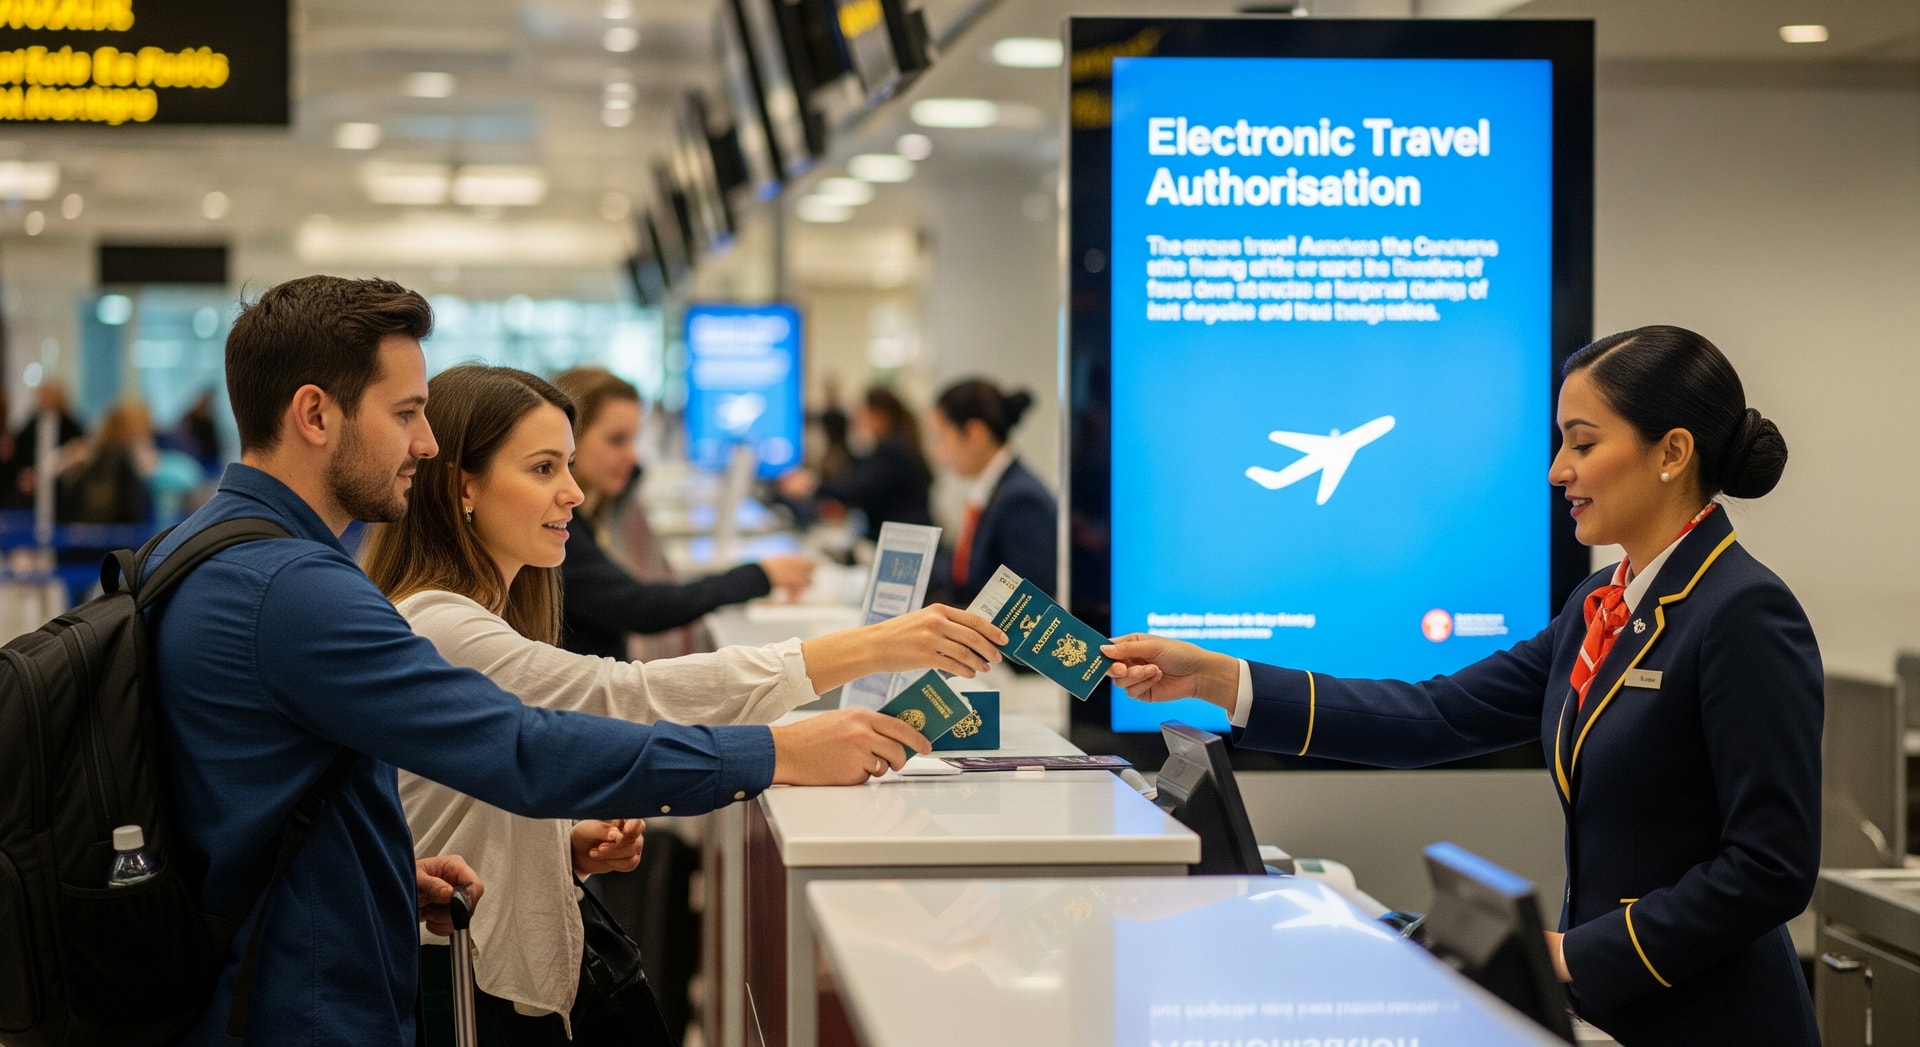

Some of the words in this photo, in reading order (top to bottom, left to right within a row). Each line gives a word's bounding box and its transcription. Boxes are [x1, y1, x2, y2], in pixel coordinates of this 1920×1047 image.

[1148, 117, 1355, 157] Electronic
[1363, 117, 1490, 157] Travel
[1146, 167, 1421, 206] Authorisation
